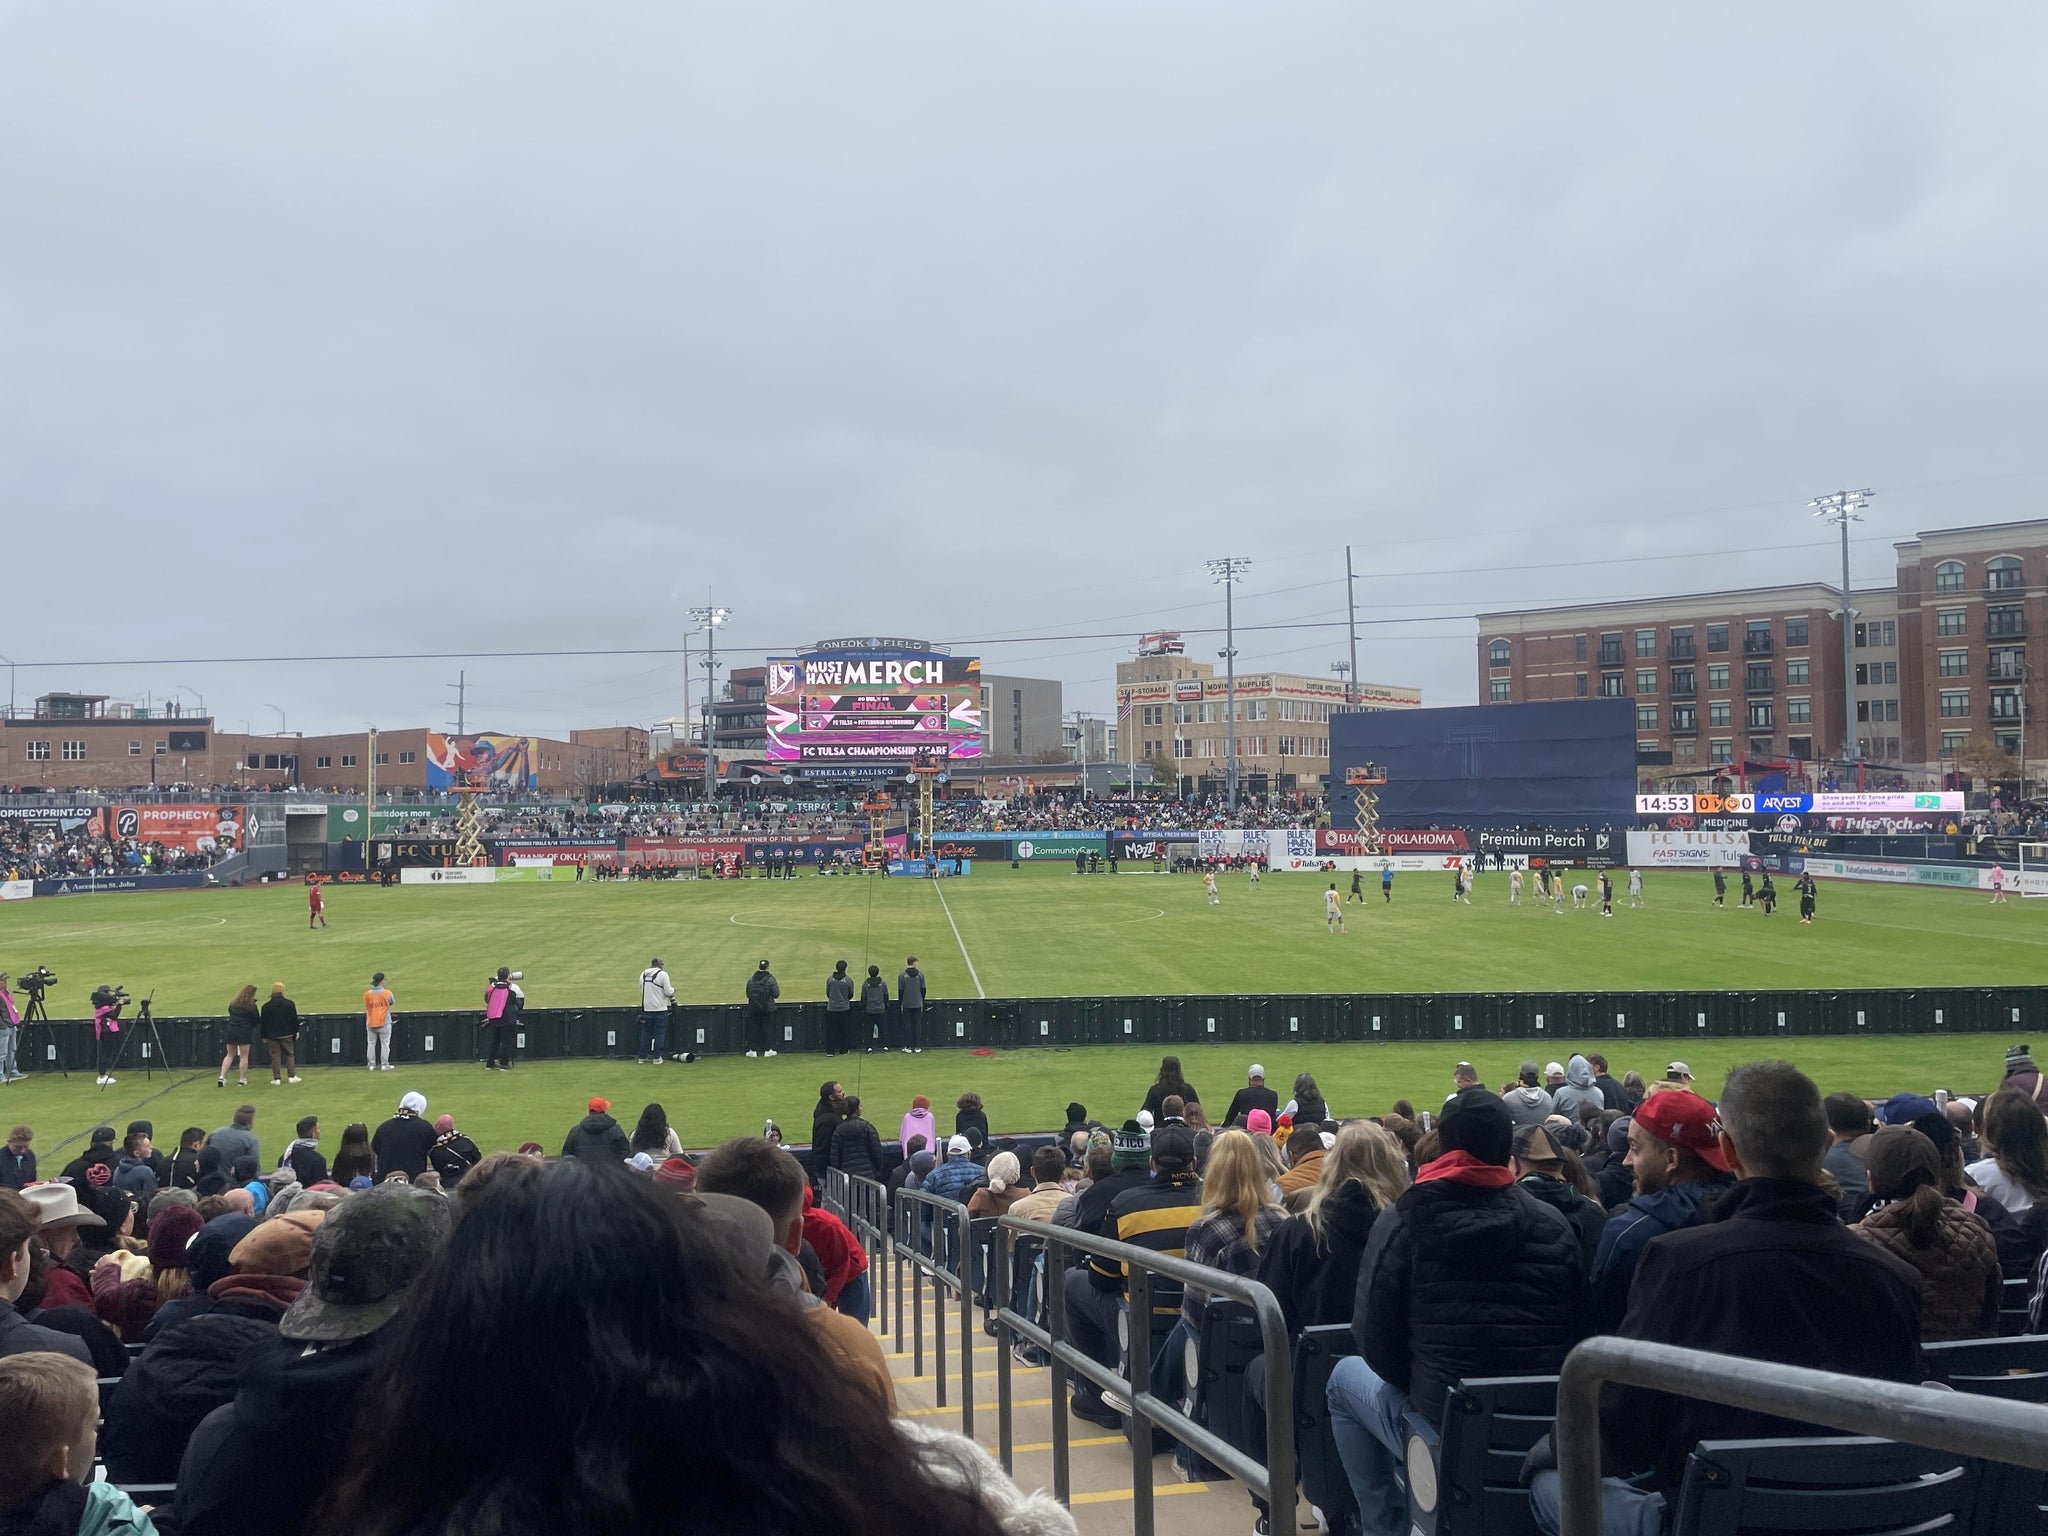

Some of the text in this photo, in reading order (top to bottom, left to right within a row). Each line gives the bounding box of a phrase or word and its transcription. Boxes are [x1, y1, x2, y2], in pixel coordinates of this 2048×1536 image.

[822, 639, 923, 650] ONEOK FIELD
[806, 661, 844, 673] MUST
[844, 660, 943, 684] MERCH
[806, 673, 842, 685] HAVE
[1238, 680, 1270, 688] SUPPLIES
[852, 702, 895, 711] FINAL
[803, 748, 815, 757] FC
[817, 747, 845, 756] TULSA
[848, 746, 916, 756] CHAMPIONSHIP
[639, 804, 680, 813] TERCE
[797, 802, 838, 811] TERRAE
[1641, 797, 1689, 811] 14:53
[1699, 797, 1709, 810] 0
[1742, 797, 1752, 810] 0
[1763, 797, 1802, 811] ARVEST
[143, 810, 210, 820] PROPHECY
[389, 809, 409, 817] does
[520, 806, 560, 815] TERRCE
[1703, 819, 1748, 827] MEDICINE
[1845, 816, 1933, 831] TulsaTech.eu
[1201, 830, 1218, 839] BLUE
[1243, 830, 1261, 839] BLUE
[1287, 830, 1305, 839] BLUE
[1388, 834, 1456, 844] OKLAHOMA
[1480, 832, 1586, 847] Premium Perch
[1651, 832, 1749, 845] FC TULSA
[1287, 839, 1313, 847] HAVEN
[1768, 834, 1792, 843] TULSA
[1794, 835, 1806, 845] TIL
[1813, 838, 1828, 847] DIE
[397, 843, 487, 857] FC TULA
[656, 847, 741, 862] Budweiser
[941, 842, 977, 858] Osage
[1287, 847, 1313, 856] POOLS
[1653, 849, 1710, 858] FASTSIGNS
[560, 852, 612, 861] OKLAHOMA
[1302, 860, 1327, 868] TulsaTe
[1846, 865, 1907, 877] TulsaSpineAndRehab.com
[72, 882, 108, 890] Ascension
[1114, 1135, 1144, 1148] EXICO
